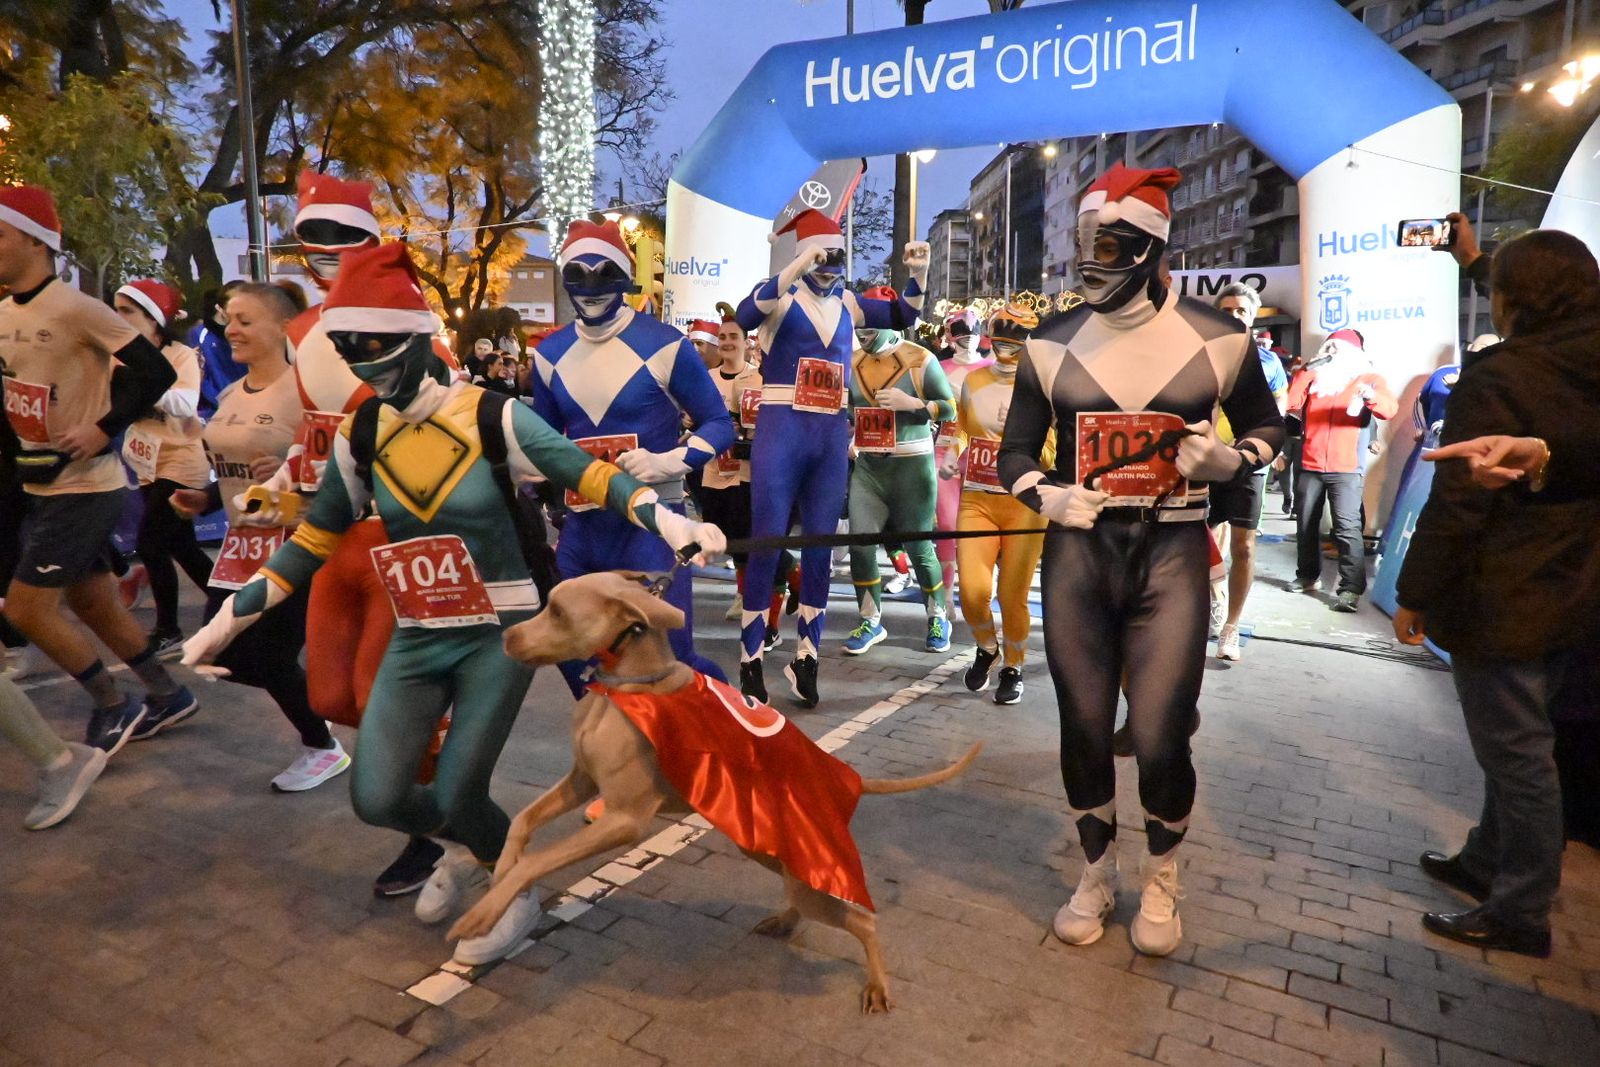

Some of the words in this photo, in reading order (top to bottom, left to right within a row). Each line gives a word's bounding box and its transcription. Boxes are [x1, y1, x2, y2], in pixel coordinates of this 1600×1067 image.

[806, 46, 976, 108] Huelva
[996, 4, 1198, 90] original
[1319, 224, 1398, 257] Huelv
[666, 257, 721, 277] Huelva
[1357, 306, 1425, 322] HUELVA
[129, 438, 152, 461] 486
[223, 536, 277, 561] 2031
[386, 552, 480, 593] 1041
